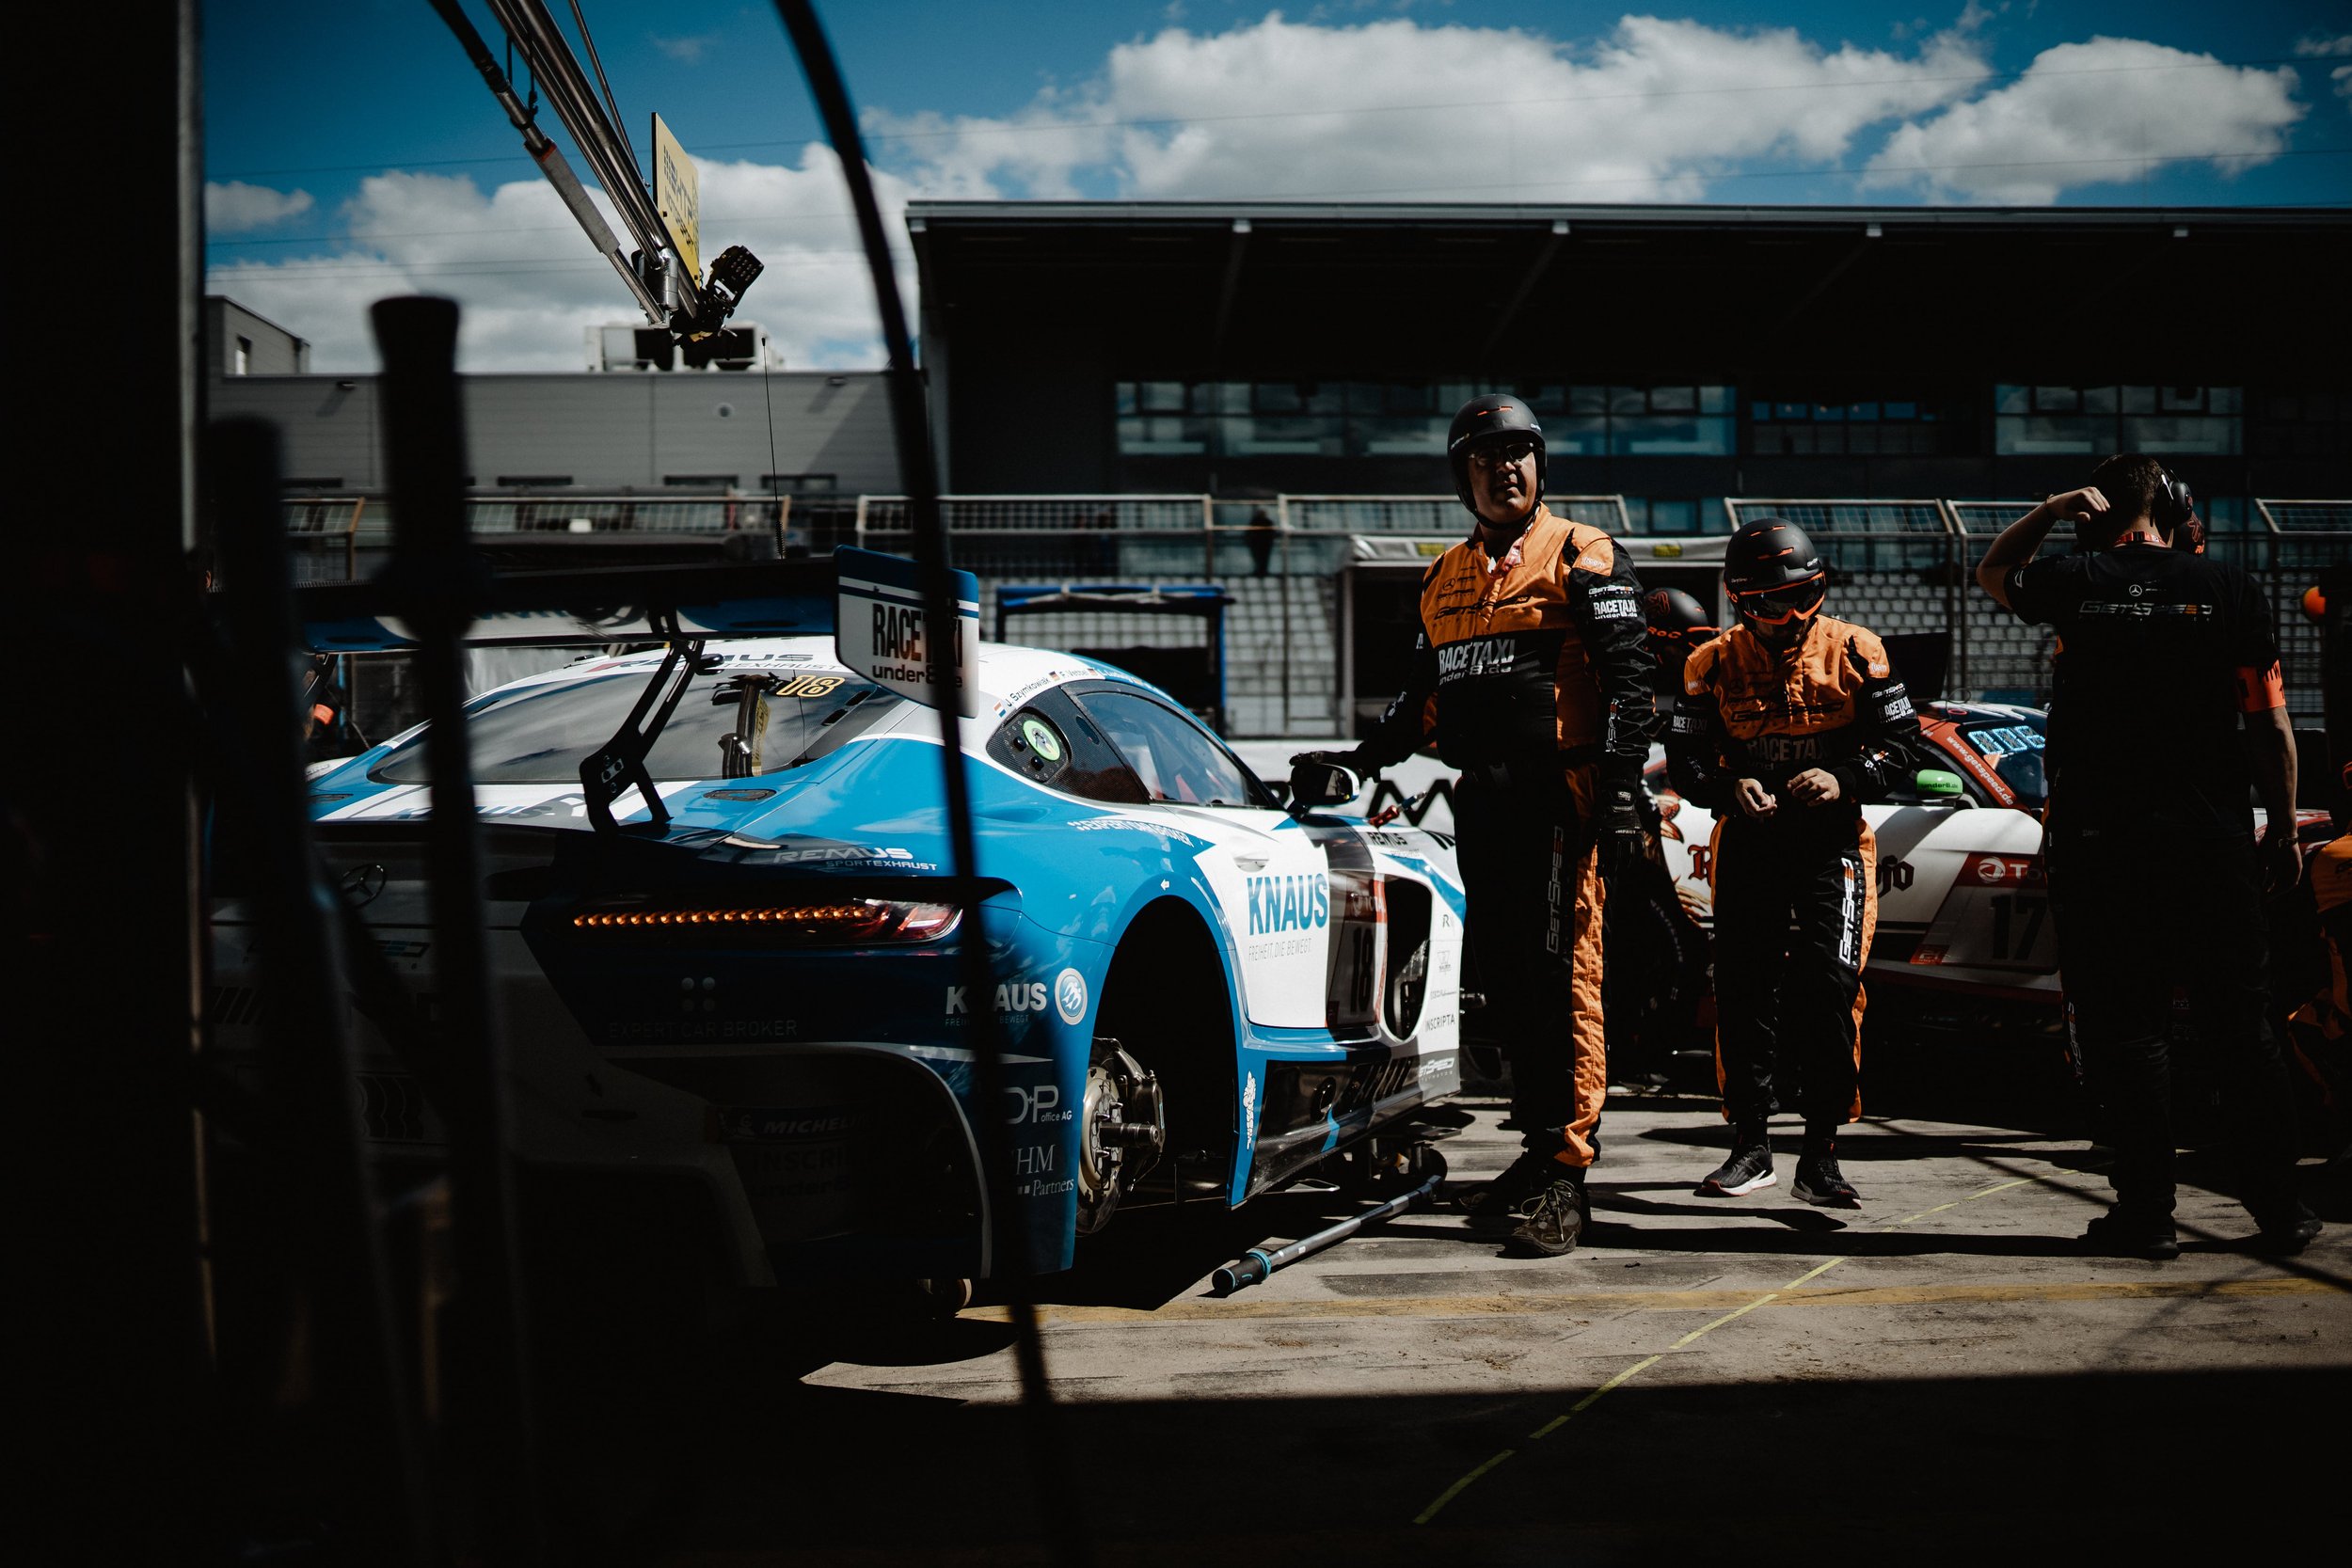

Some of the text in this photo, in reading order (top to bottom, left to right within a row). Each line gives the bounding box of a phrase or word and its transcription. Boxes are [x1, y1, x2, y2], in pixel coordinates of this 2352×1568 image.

[1593, 599, 1637, 615] RACETAXI
[1438, 639, 1516, 676] RACETAXI
[776, 674, 846, 697] 18
[1009, 677, 1051, 702] Szymkowiak
[1946, 736, 2014, 806] www.getspeed.de
[772, 847, 914, 863] REMUS
[825, 860, 938, 871] SPORTEXHAUST
[1247, 873, 1328, 936] KNAUS
[1991, 895, 2048, 960] 17
[946, 983, 1047, 1015] KAUS
[609, 1020, 799, 1038] EXPERT CAR BROKER
[1425, 1013, 1455, 1033] INSCRIPTA
[1041, 1110, 1073, 1123] office AG
[1032, 1178, 1074, 1197] Partners
